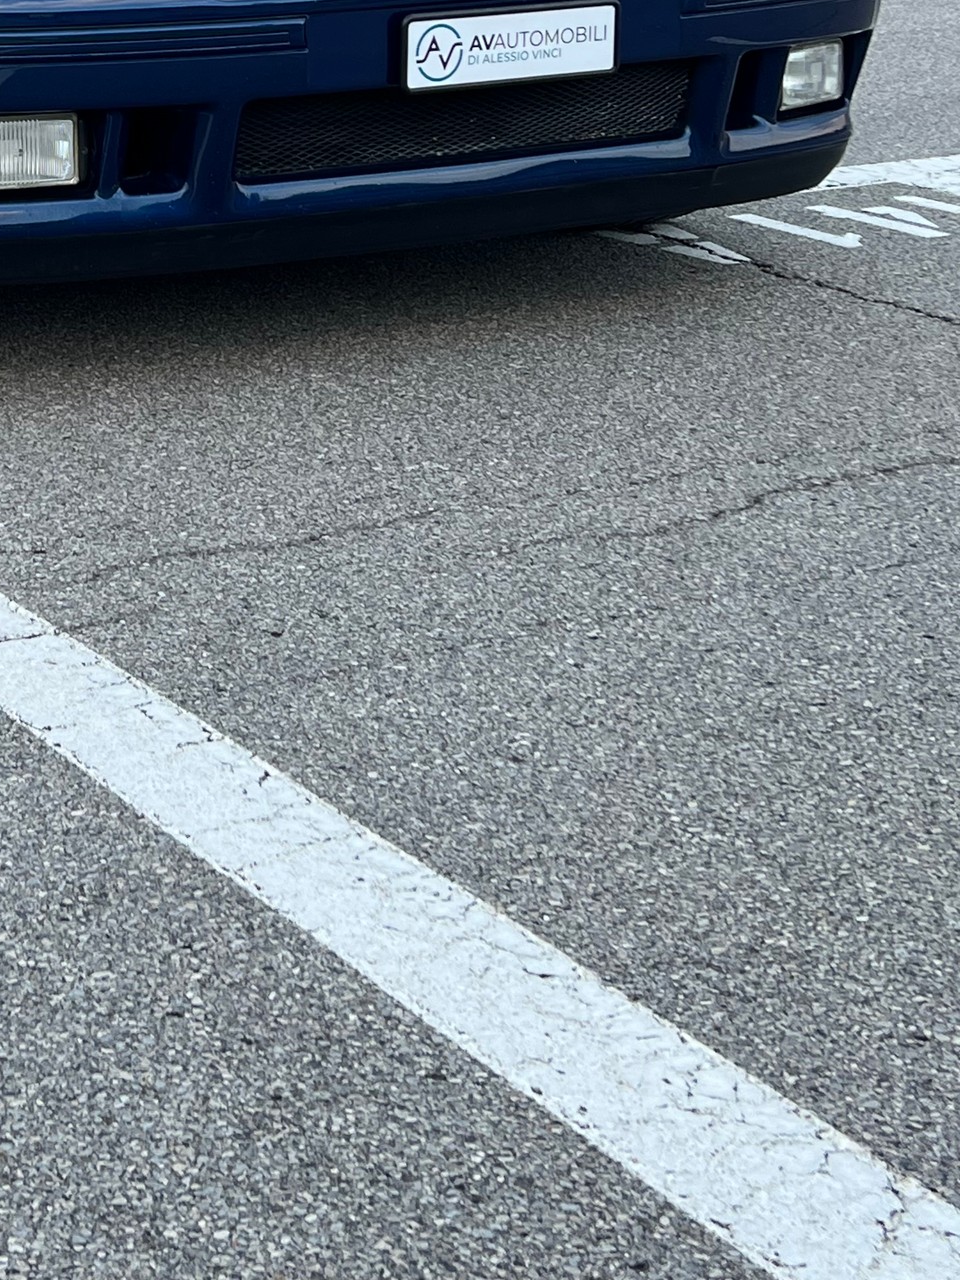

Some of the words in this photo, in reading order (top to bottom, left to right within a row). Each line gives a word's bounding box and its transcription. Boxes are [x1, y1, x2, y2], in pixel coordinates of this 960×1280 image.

[467, 53, 480, 66] DI
[482, 50, 529, 64] ALESSIO
[532, 47, 562, 60] VINCI
